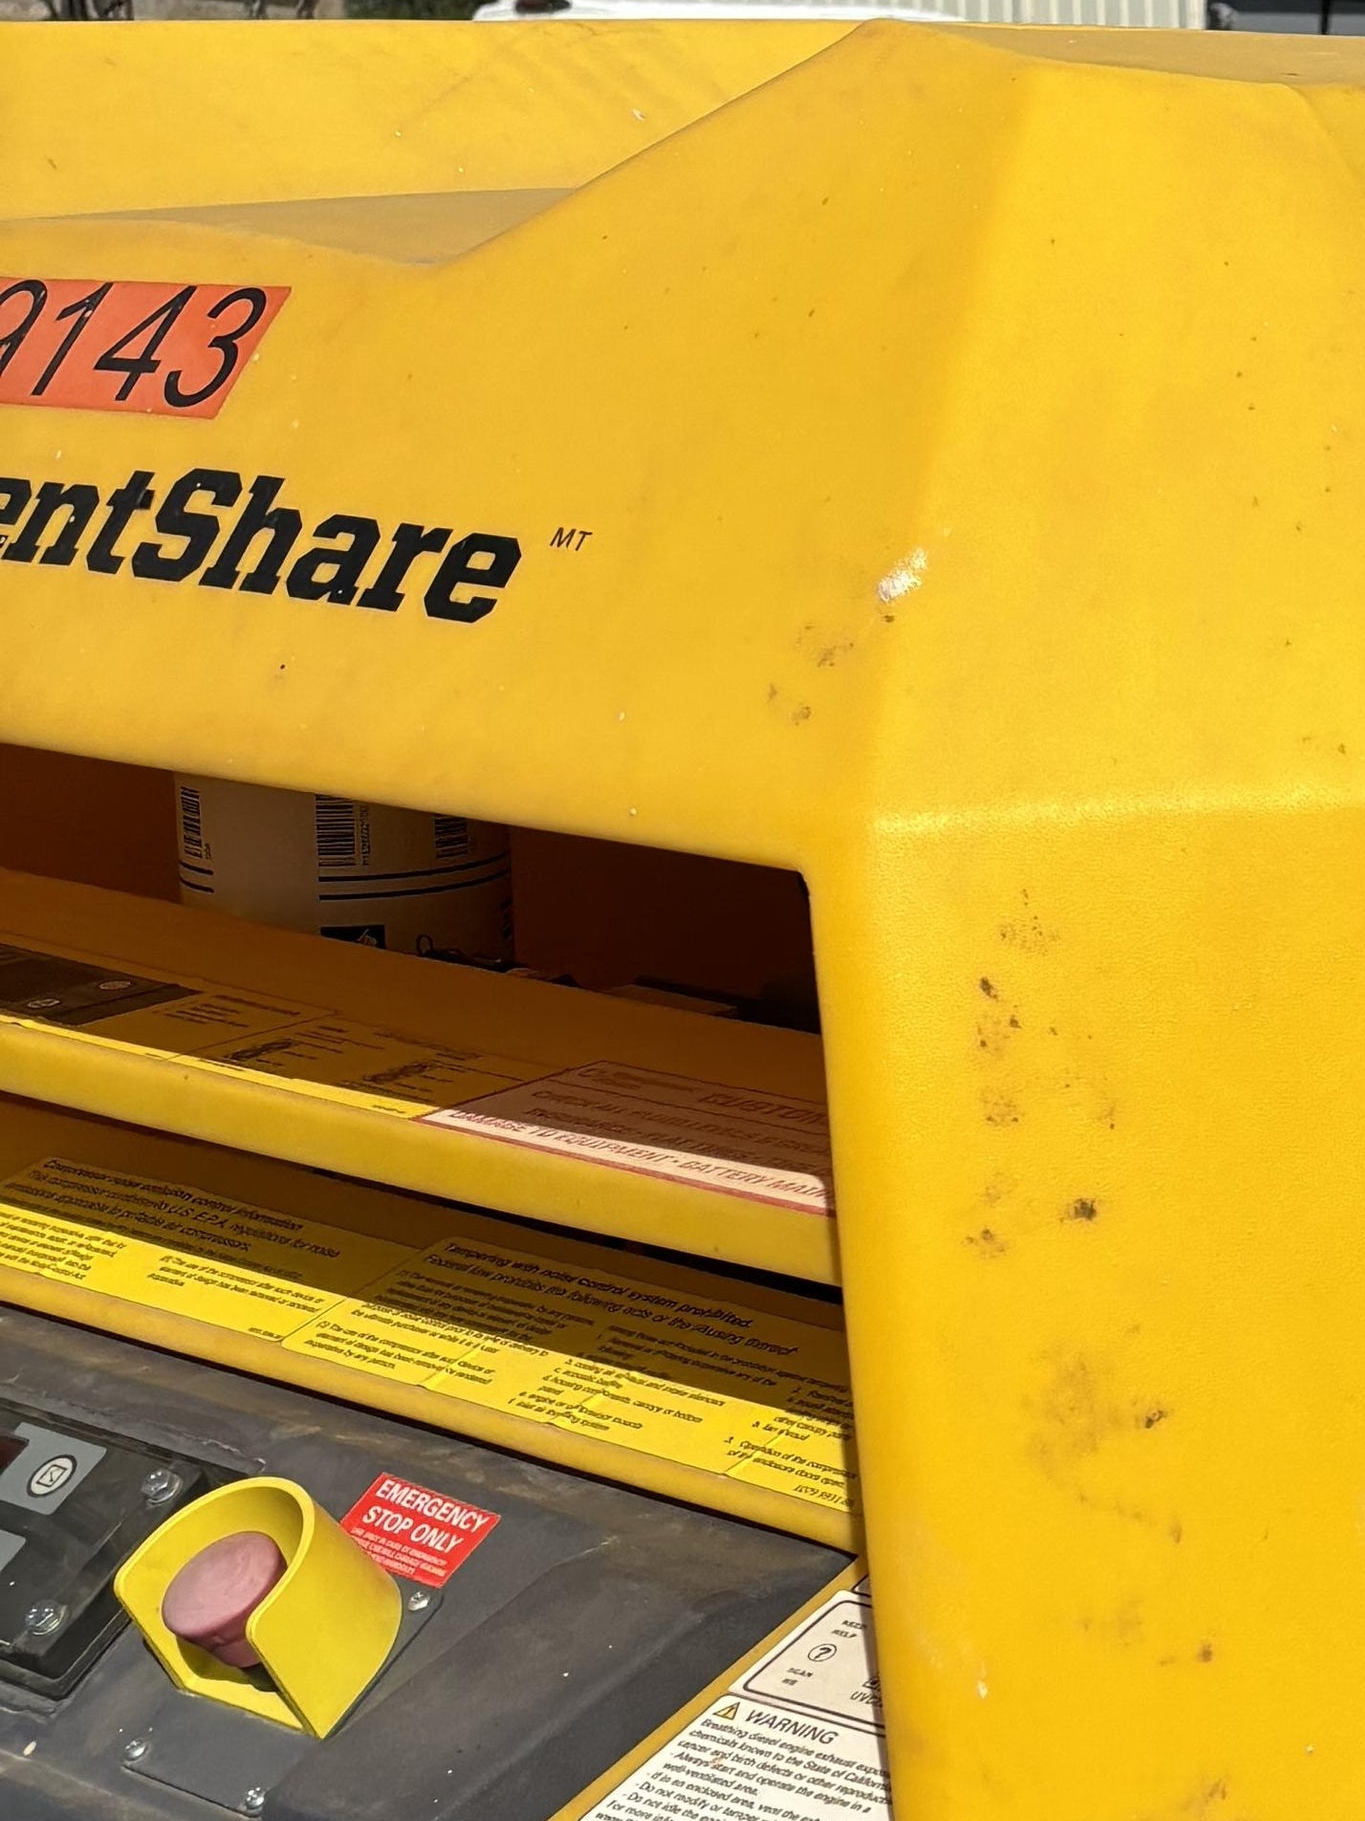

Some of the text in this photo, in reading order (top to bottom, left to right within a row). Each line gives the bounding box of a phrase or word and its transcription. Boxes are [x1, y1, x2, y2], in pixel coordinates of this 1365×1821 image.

[529, 1128, 555, 1137] TO
[555, 1135, 673, 1161] EQUIPMENT
[679, 1161, 768, 1183] BATTERY
[445, 1243, 510, 1267] Tampering
[511, 1262, 540, 1273] with
[628, 1292, 678, 1311] system
[362, 1505, 463, 1553] STOP ONLY
[376, 1479, 490, 1533] EMERGENCY
[701, 1719, 856, 1767] Breathing diesel engine exhaust
[747, 1711, 837, 1743] WARNING
[664, 1764, 735, 1787] well-ventilated
[678, 1741, 710, 1752] cancer
[710, 1750, 733, 1759] and
[731, 1754, 756, 1766] birth
[756, 1762, 792, 1777] defects
[807, 1777, 834, 1788] other
[689, 1730, 845, 1778] chemicals known to the State of
[627, 1792, 643, 1802] Do
[643, 1799, 662, 1808] not
[661, 1804, 681, 1814] idle
[681, 1809, 699, 1819] the
[639, 1781, 655, 1792] Do
[655, 1788, 674, 1797] not
[674, 1794, 709, 1809] modify
[709, 1804, 723, 1812] or
[723, 1807, 759, 1821] tamper
[651, 1772, 663, 1780] If
[659, 1775, 671, 1783] in
[671, 1779, 685, 1787] an
[686, 1784, 731, 1800] enclosed
[758, 1804, 780, 1815] vent
[781, 1811, 799, 1820] the
[675, 1752, 713, 1767] Always
[711, 1762, 734, 1774] start
[735, 1770, 756, 1780] and
[756, 1776, 795, 1791] operate
[795, 1787, 814, 1797] the
[814, 1793, 850, 1807] engine
[850, 1803, 862, 1811] in
[607, 1800, 624, 1810] For
[625, 1807, 652, 1819] more
